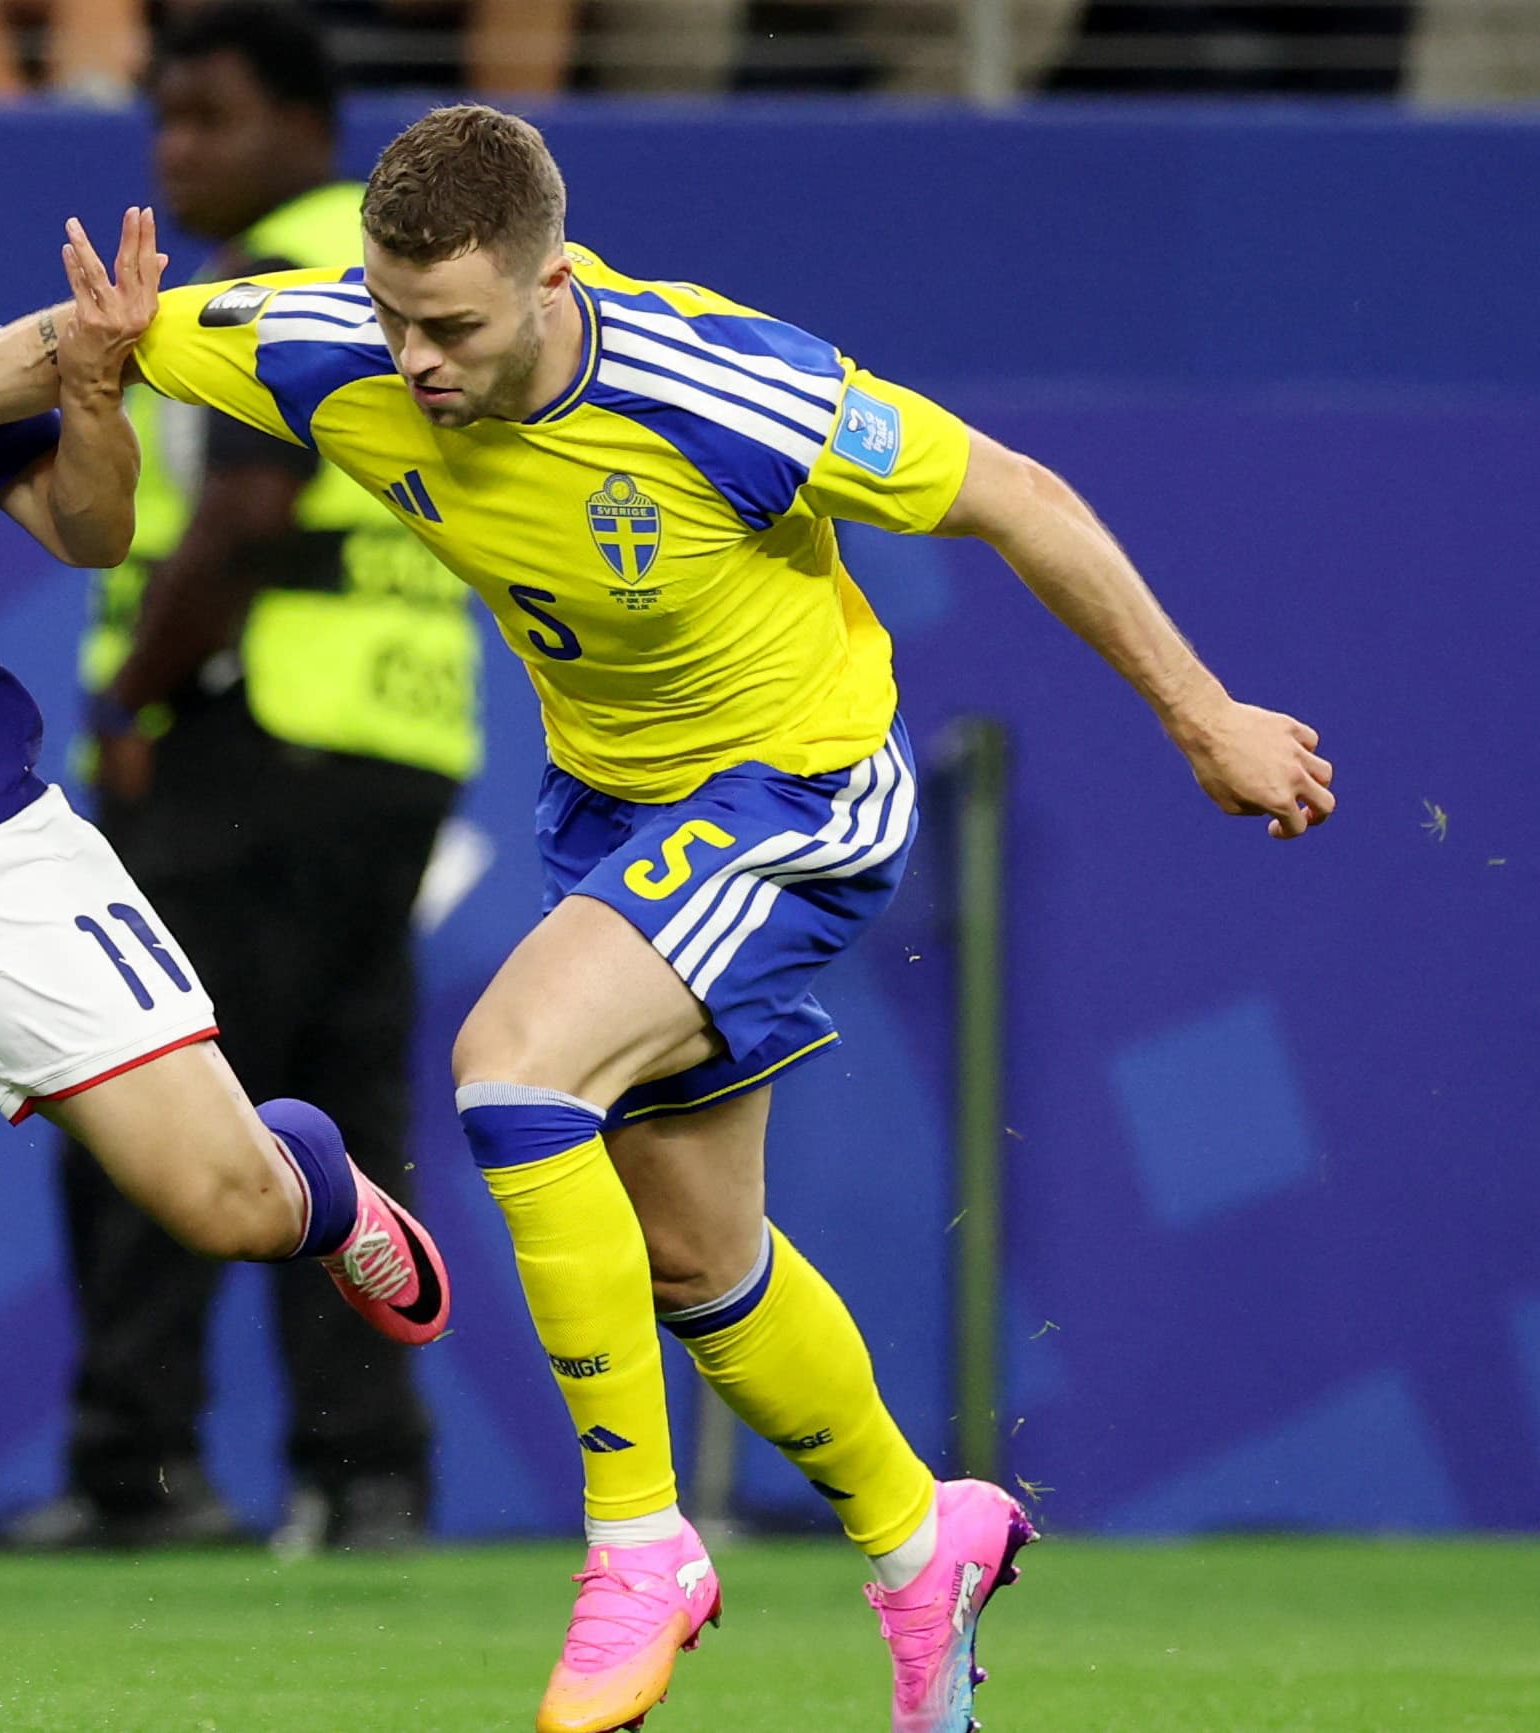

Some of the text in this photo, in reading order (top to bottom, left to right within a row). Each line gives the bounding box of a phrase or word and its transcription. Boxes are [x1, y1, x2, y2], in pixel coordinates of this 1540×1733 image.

[596, 506, 649, 517] SVERIGE
[623, 819, 737, 901] 5
[74, 902, 193, 1011] 11
